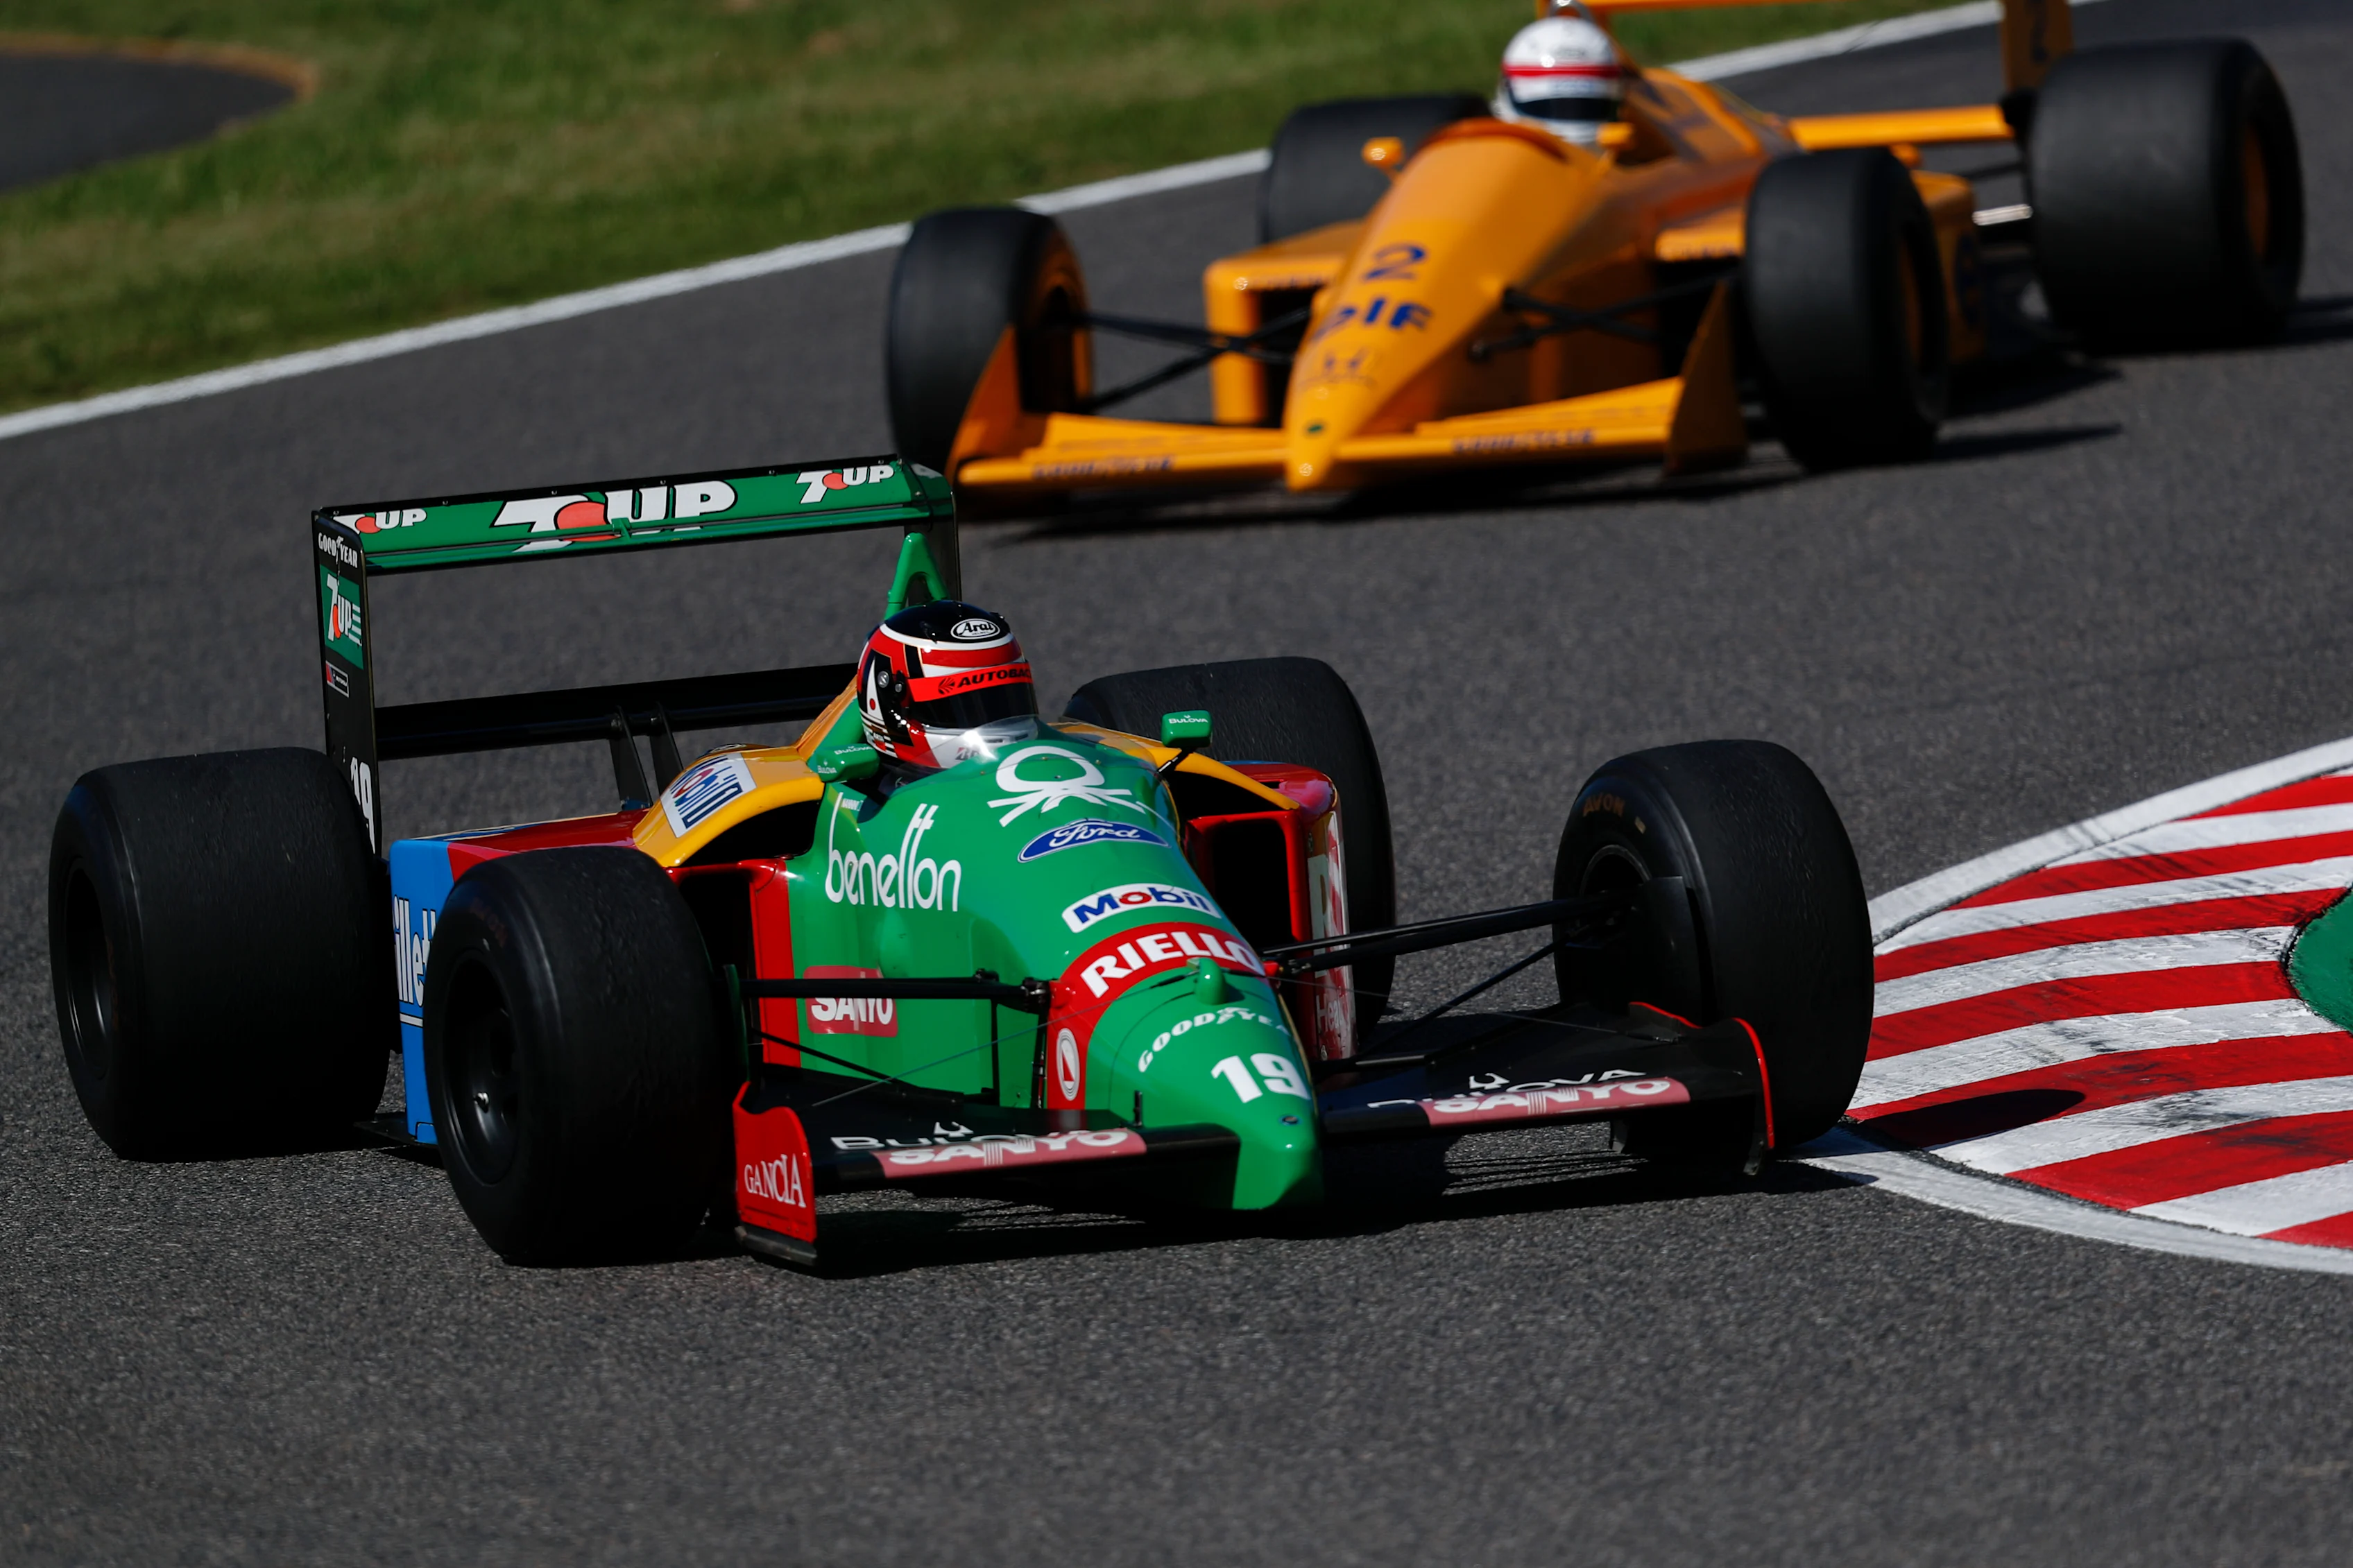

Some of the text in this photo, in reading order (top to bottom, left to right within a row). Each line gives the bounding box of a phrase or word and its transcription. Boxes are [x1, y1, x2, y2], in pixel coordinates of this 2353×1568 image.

[1366, 244, 1426, 280] 2
[795, 464, 895, 504] 7UP
[493, 480, 737, 553] 7UP
[958, 621, 994, 636] Arai
[957, 669, 1032, 688] AUTOBAC
[1582, 792, 1625, 818] AVON
[1048, 818, 1141, 847] Ford
[1073, 888, 1210, 924] Mobil
[393, 894, 436, 1007] illet
[1080, 931, 1266, 999] RIELLO
[1211, 1053, 1311, 1103] 19
[1433, 1080, 1670, 1114] SANYO
[889, 1128, 1129, 1166] SANYO
[744, 1153, 807, 1208] GANCIA
